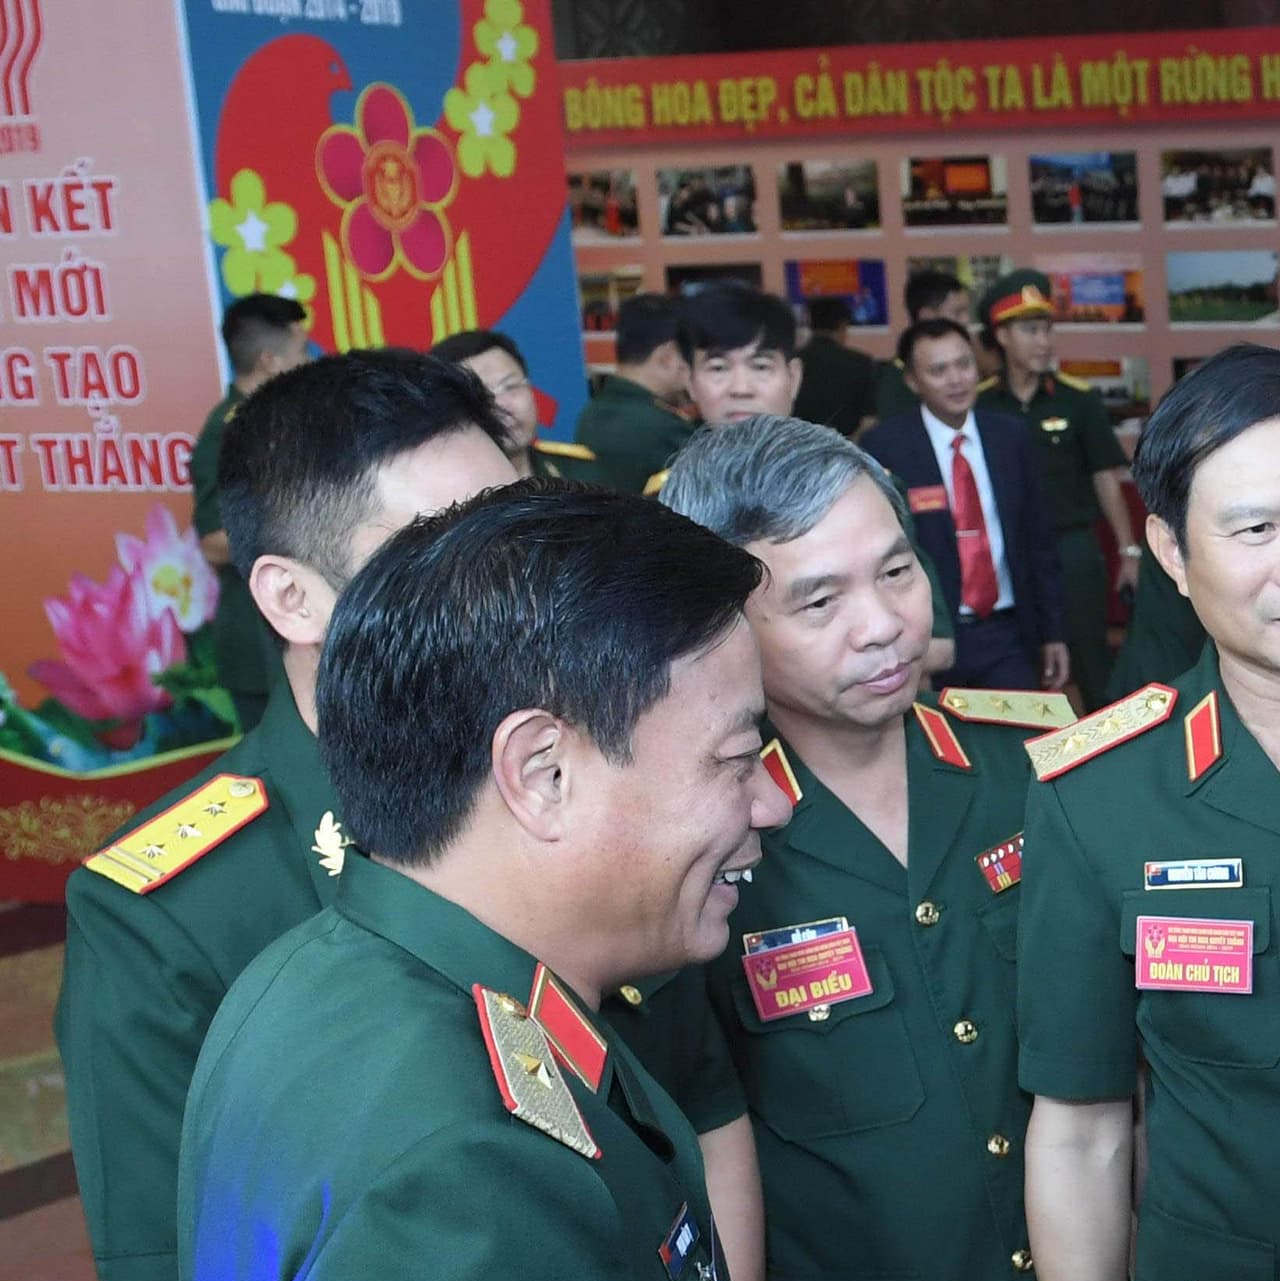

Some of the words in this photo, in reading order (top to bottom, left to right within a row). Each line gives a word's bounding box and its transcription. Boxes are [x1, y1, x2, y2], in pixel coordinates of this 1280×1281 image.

[651, 80, 713, 127] HOA
[916, 57, 977, 124] TỘC
[984, 63, 1025, 110] TA
[1031, 52, 1074, 111] LÀ
[26, 157, 116, 235] KẾT
[11, 249, 109, 320] MỚI
[48, 349, 143, 411] TẠO
[35, 417, 195, 487] THẮNG
[774, 984, 808, 1009] ĐẠI
[809, 970, 853, 999] BIỂU
[1149, 959, 1183, 981] ĐOÀN
[1185, 957, 1210, 983] CHỦ
[1213, 964, 1240, 987] TỊCH
